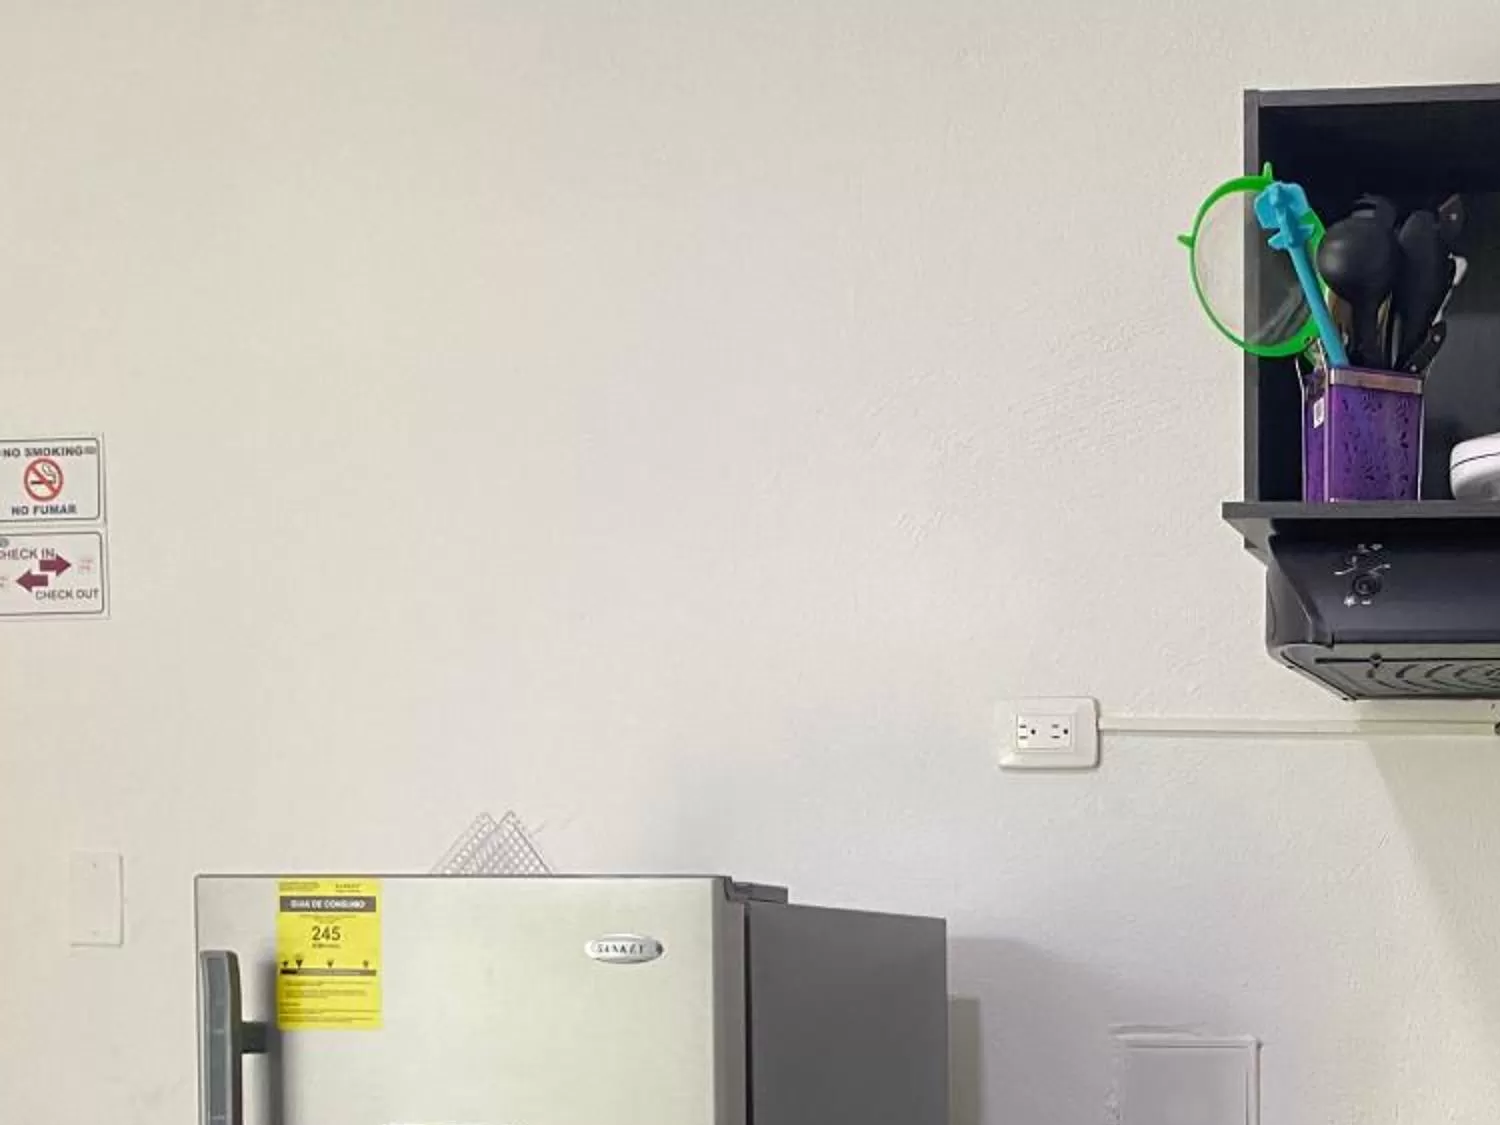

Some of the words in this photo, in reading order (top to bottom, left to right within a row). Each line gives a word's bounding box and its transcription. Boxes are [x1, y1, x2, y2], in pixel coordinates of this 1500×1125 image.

[3, 447, 21, 457] NO
[24, 445, 83, 457] SMOKING
[11, 506, 29, 516] NO
[33, 504, 77, 515] FUMAR
[41, 548, 55, 559] IN
[35, 588, 73, 600] CHECK
[76, 587, 99, 599] OUT
[311, 925, 341, 941] 245
